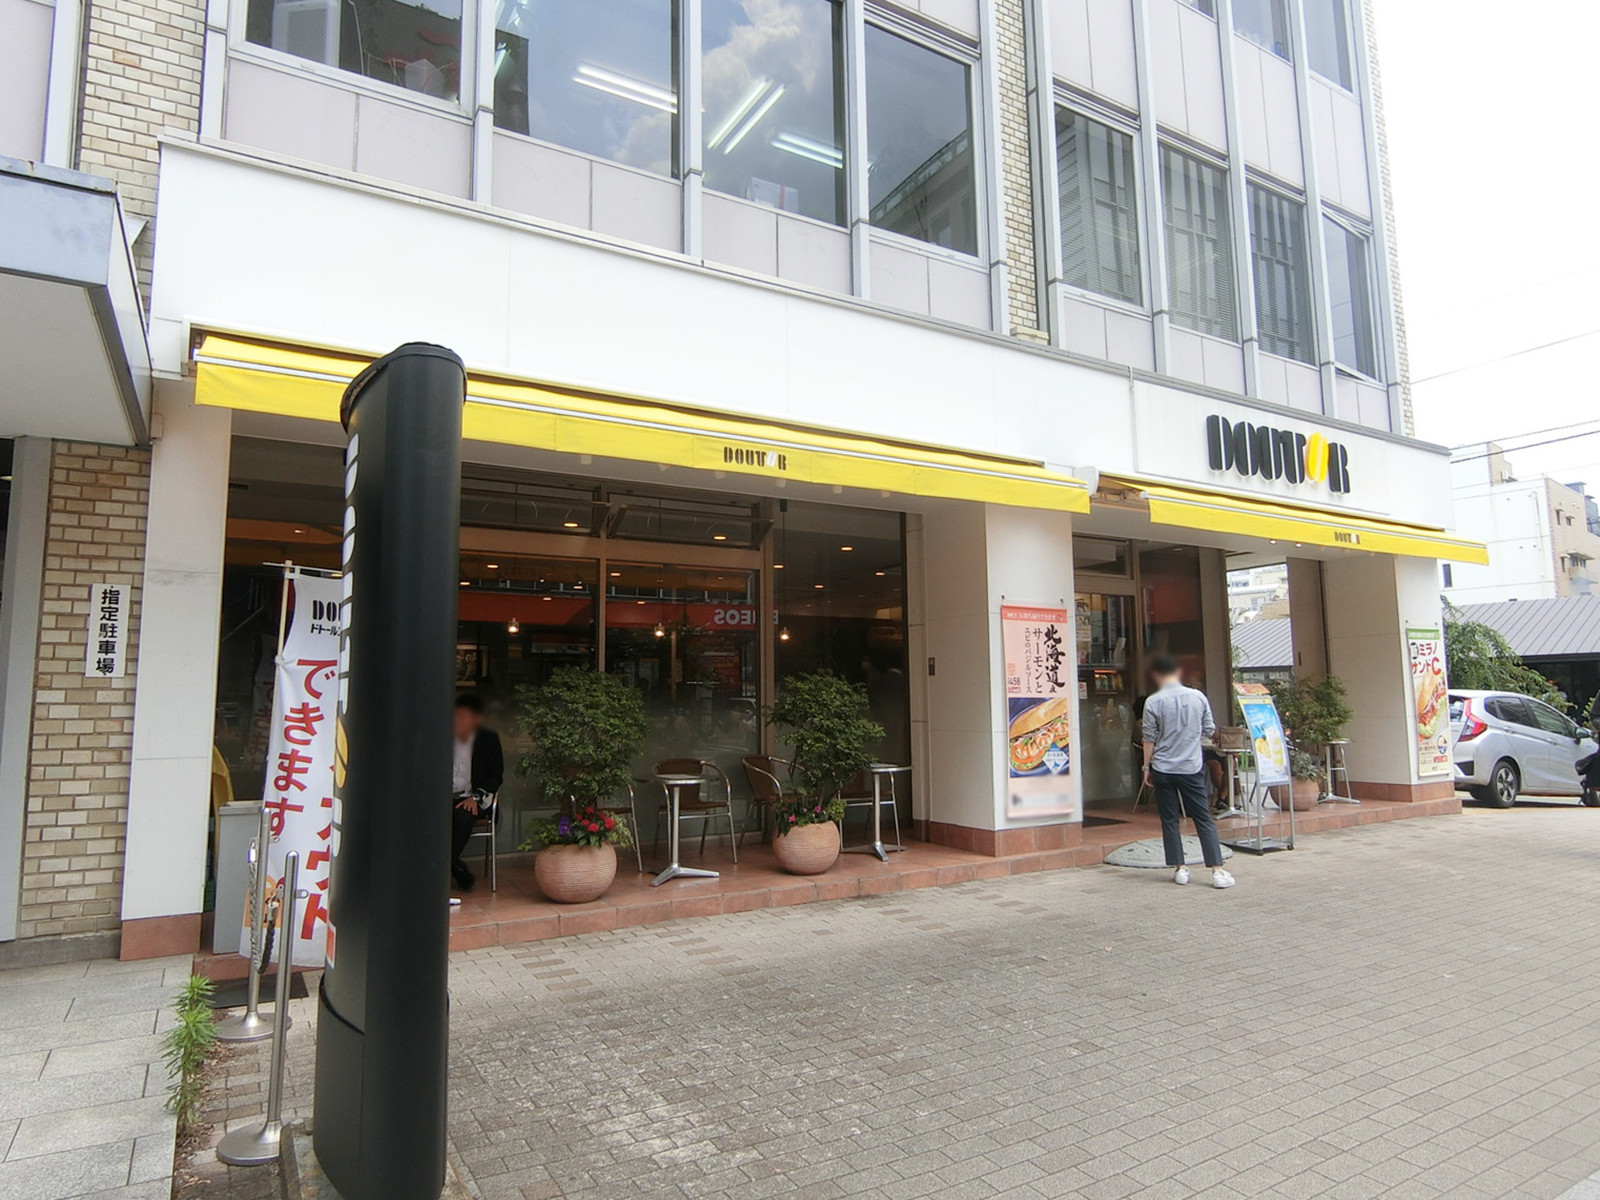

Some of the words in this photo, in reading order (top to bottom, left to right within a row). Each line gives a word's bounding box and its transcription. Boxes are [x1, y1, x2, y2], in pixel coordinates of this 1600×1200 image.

[723, 446, 787, 471] DOUTOR
[1206, 414, 1351, 494] DOUTOR
[95, 588, 121, 675] 指定駐車場
[310, 623, 340, 638] ドトール
[312, 599, 341, 622] DO
[1032, 627, 1044, 693] サーモンと
[1420, 641, 1437, 656] ミラノ
[264, 658, 338, 838] できます
